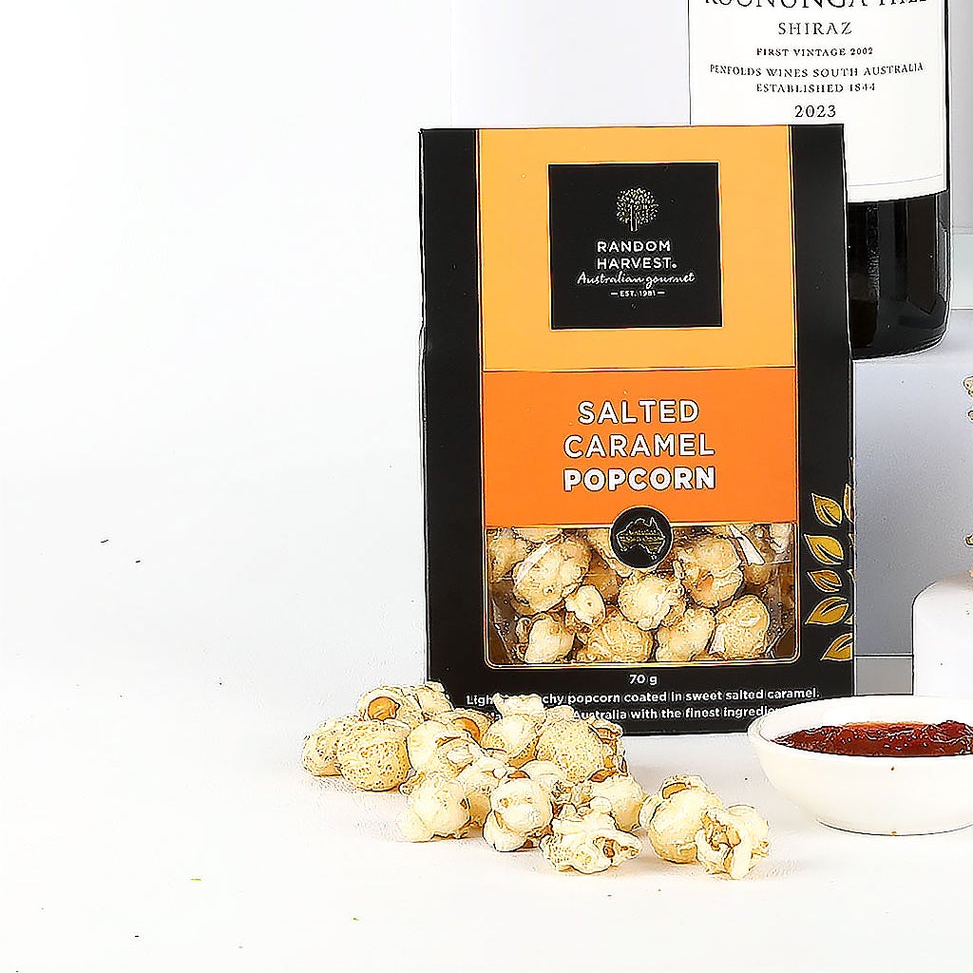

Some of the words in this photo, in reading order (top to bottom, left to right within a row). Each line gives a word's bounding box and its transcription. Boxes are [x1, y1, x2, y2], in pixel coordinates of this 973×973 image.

[778, 22, 853, 35] SHIRAZ
[757, 48, 789, 57] FIRST
[793, 48, 846, 57] VINTAGE
[850, 47, 873, 56] 2002
[710, 63, 762, 77] PENFOLDS
[766, 69, 808, 78] WINES
[813, 68, 858, 77] SOUTH
[863, 62, 924, 76] AUSTRALIA
[756, 83, 844, 93] ESTABLISHED
[794, 105, 837, 118] 2023
[597, 240, 671, 253] RANDOM
[577, 270, 645, 284] Australian
[645, 272, 695, 289] gourmet
[578, 399, 700, 425] SALTED
[563, 433, 715, 459] CARAMEL
[563, 466, 716, 491] POPCORN
[466, 694, 494, 706] Ligh
[568, 694, 620, 705] popcorn
[624, 691, 667, 702] coated
[671, 691, 682, 702] in
[686, 691, 722, 701] sweet
[725, 689, 764, 700] salted
[767, 687, 820, 699] caramel.
[631, 708, 658, 719] with
[661, 708, 682, 719] the
[685, 707, 720, 717] finest
